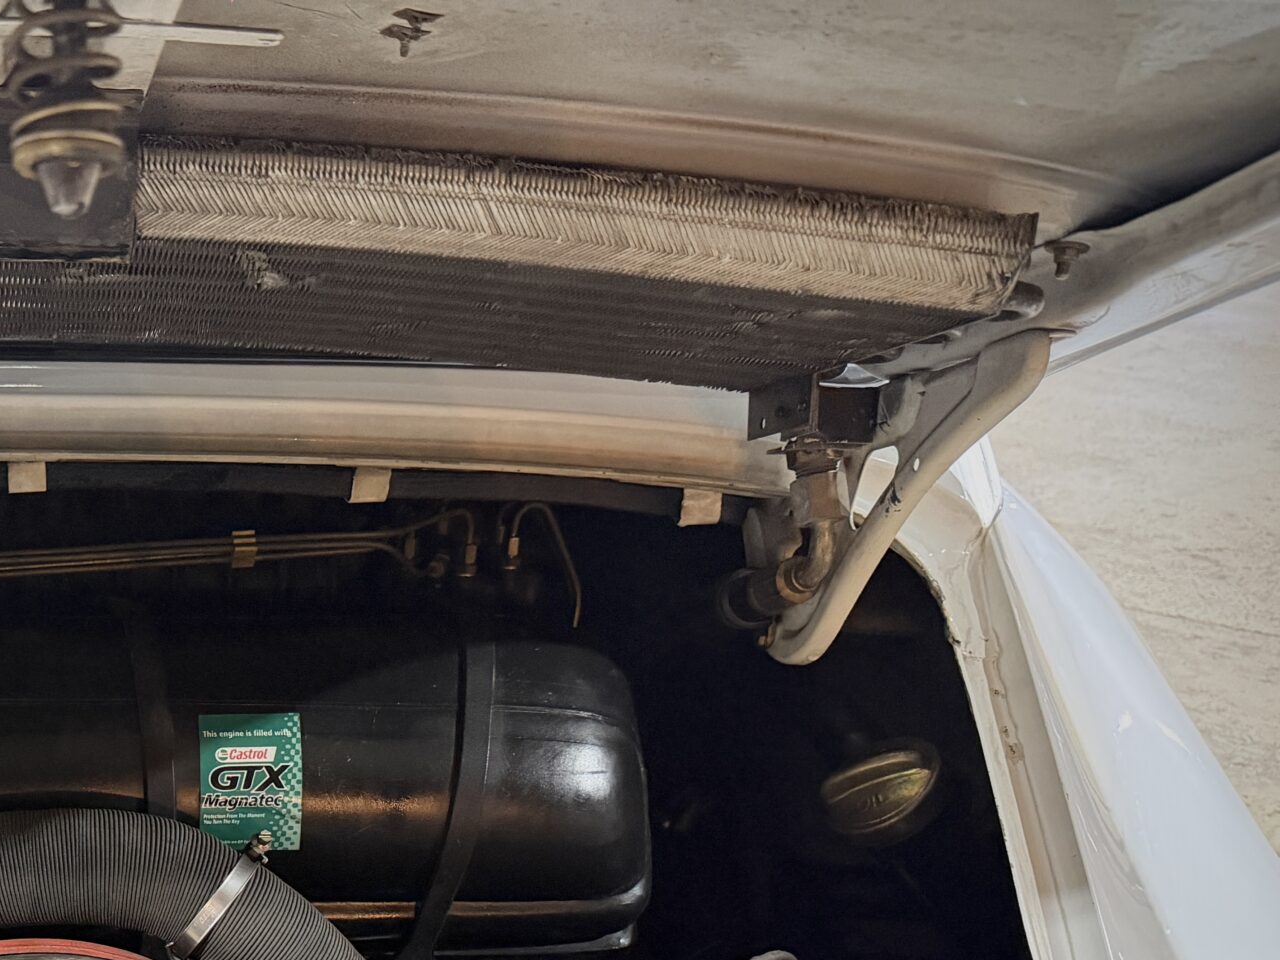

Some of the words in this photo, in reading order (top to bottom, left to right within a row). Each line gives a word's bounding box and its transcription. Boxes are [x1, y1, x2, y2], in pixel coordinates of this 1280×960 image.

[220, 730, 244, 738] engine
[229, 749, 268, 760] Castrol
[209, 763, 292, 793] GTX
[202, 793, 283, 811] Magnatec
